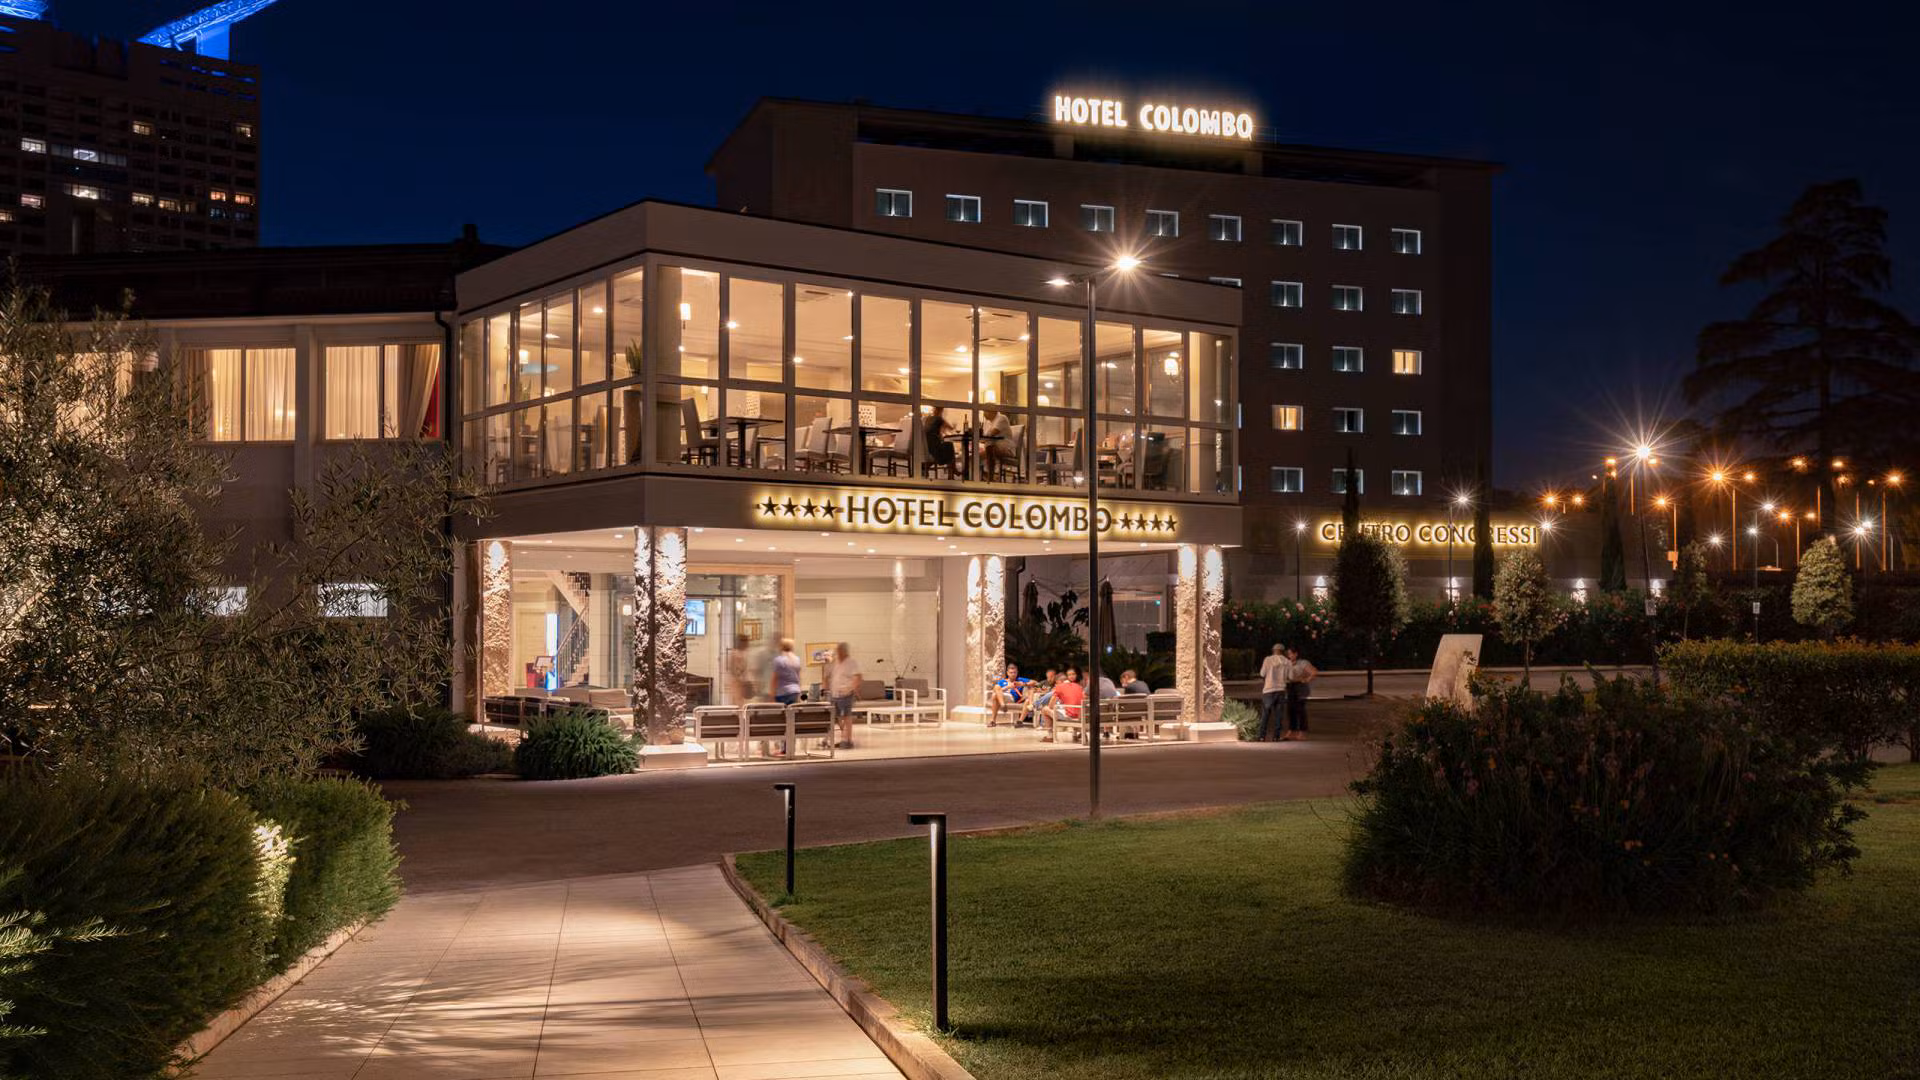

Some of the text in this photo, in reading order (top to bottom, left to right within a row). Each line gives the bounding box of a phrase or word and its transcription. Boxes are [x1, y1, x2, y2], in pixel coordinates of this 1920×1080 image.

[1055, 95, 1253, 139] HOTEL COLOMBO
[847, 495, 1112, 533] HOTEL COLOMBO
